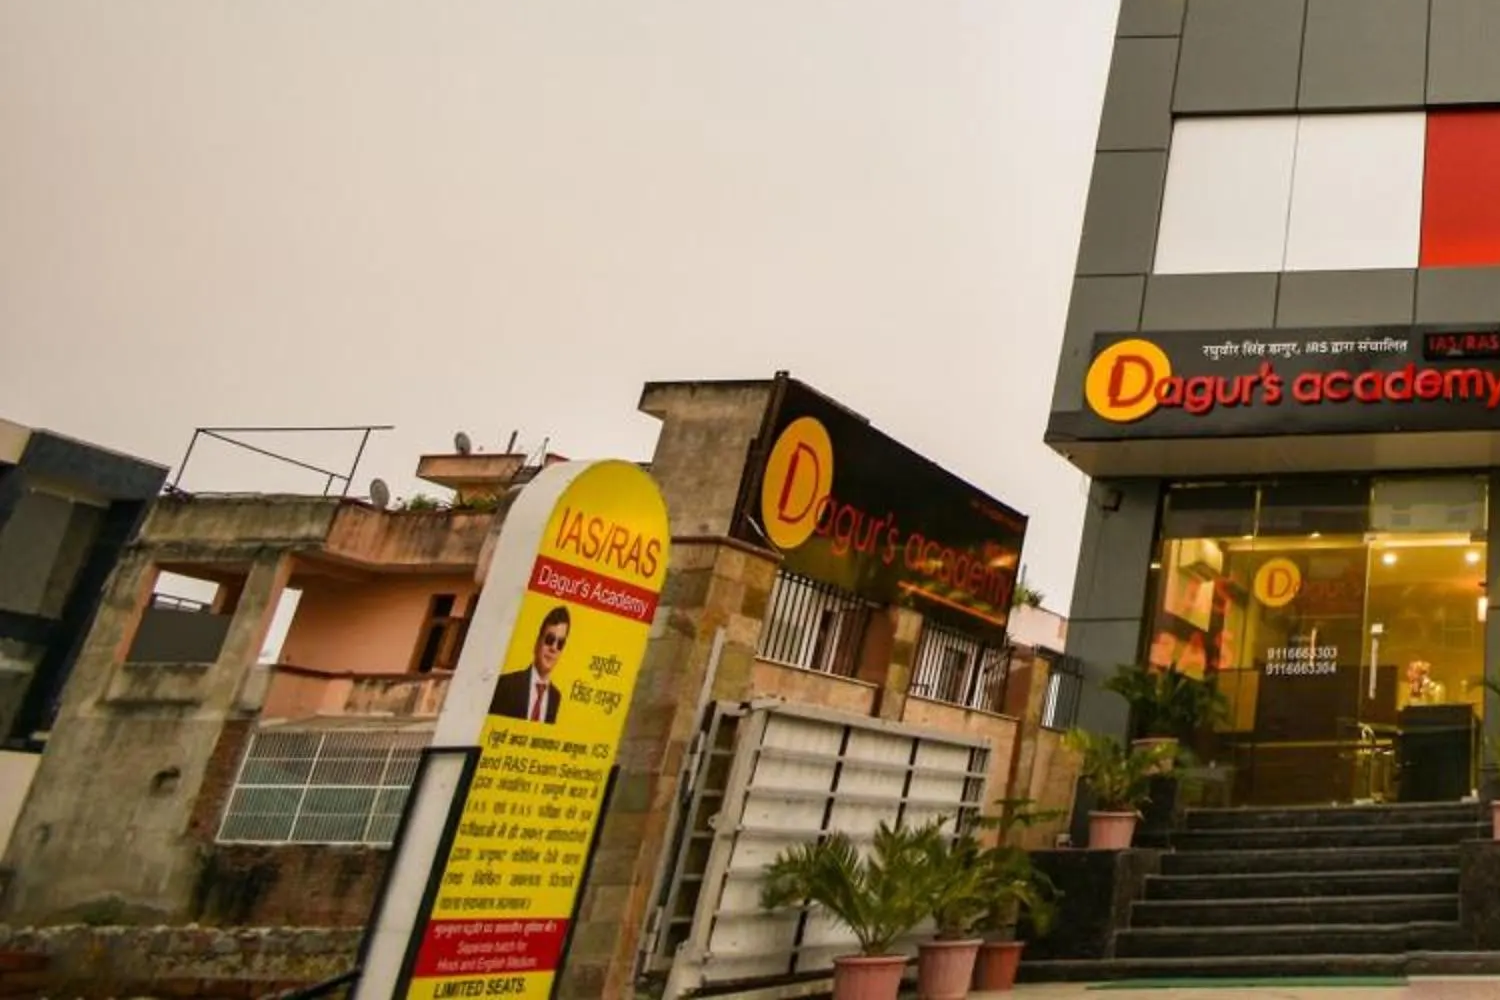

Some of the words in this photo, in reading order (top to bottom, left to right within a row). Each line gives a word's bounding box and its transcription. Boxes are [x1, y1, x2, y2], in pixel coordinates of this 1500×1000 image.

[1428, 333, 1500, 352] IAS/RAS
[1106, 354, 1284, 416] Dagur's
[777, 441, 899, 565] Dagur's
[555, 506, 662, 580] IAS/RAS
[537, 564, 591, 598] Dagur's
[591, 581, 650, 619] Academy
[432, 979, 486, 999] LIMITED
